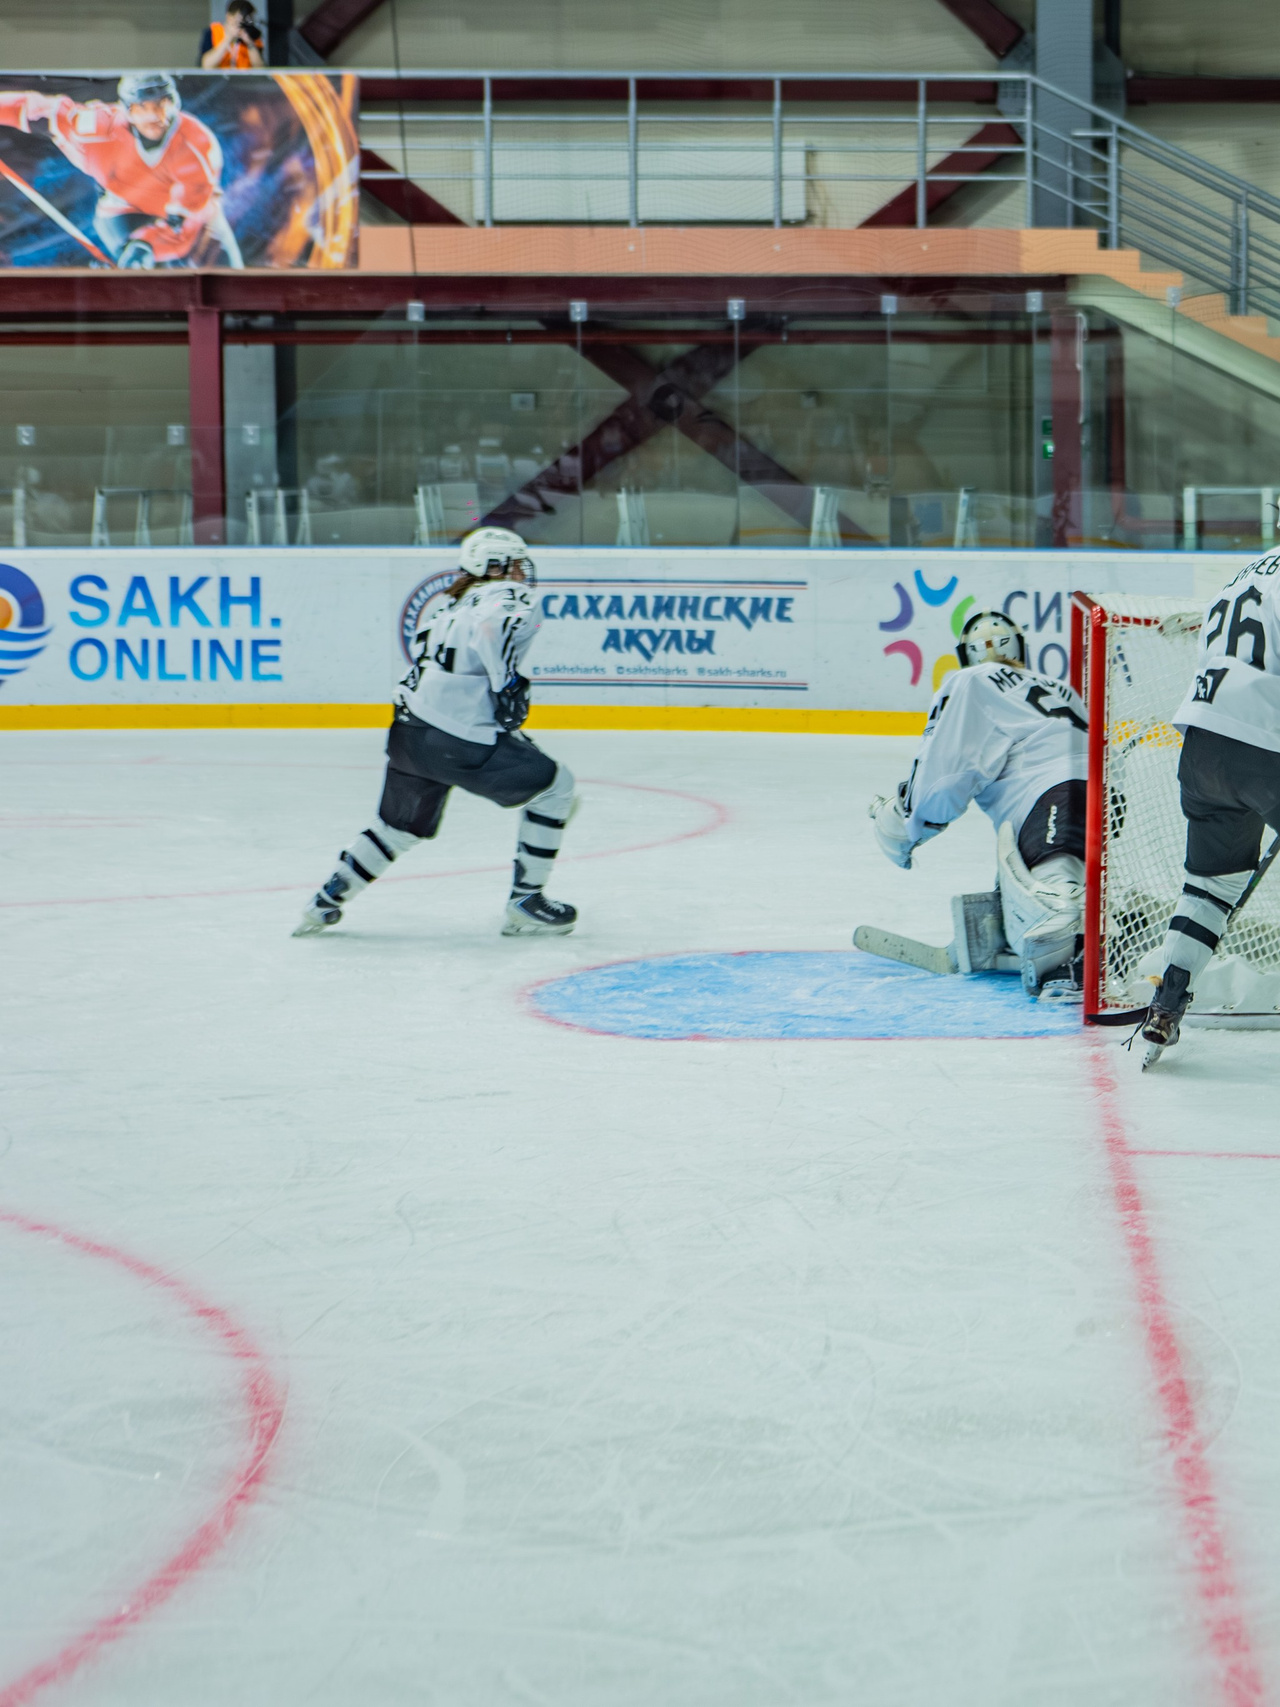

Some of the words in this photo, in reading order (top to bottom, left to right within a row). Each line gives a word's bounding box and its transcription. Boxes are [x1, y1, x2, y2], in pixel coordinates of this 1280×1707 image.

[69, 574, 282, 628] SAKH.
[541, 594, 795, 631] САХАЛИНСКИЕ
[602, 628, 717, 662] АКУЛЫ
[1205, 585, 1266, 671] 26
[69, 637, 283, 682] ONLINE
